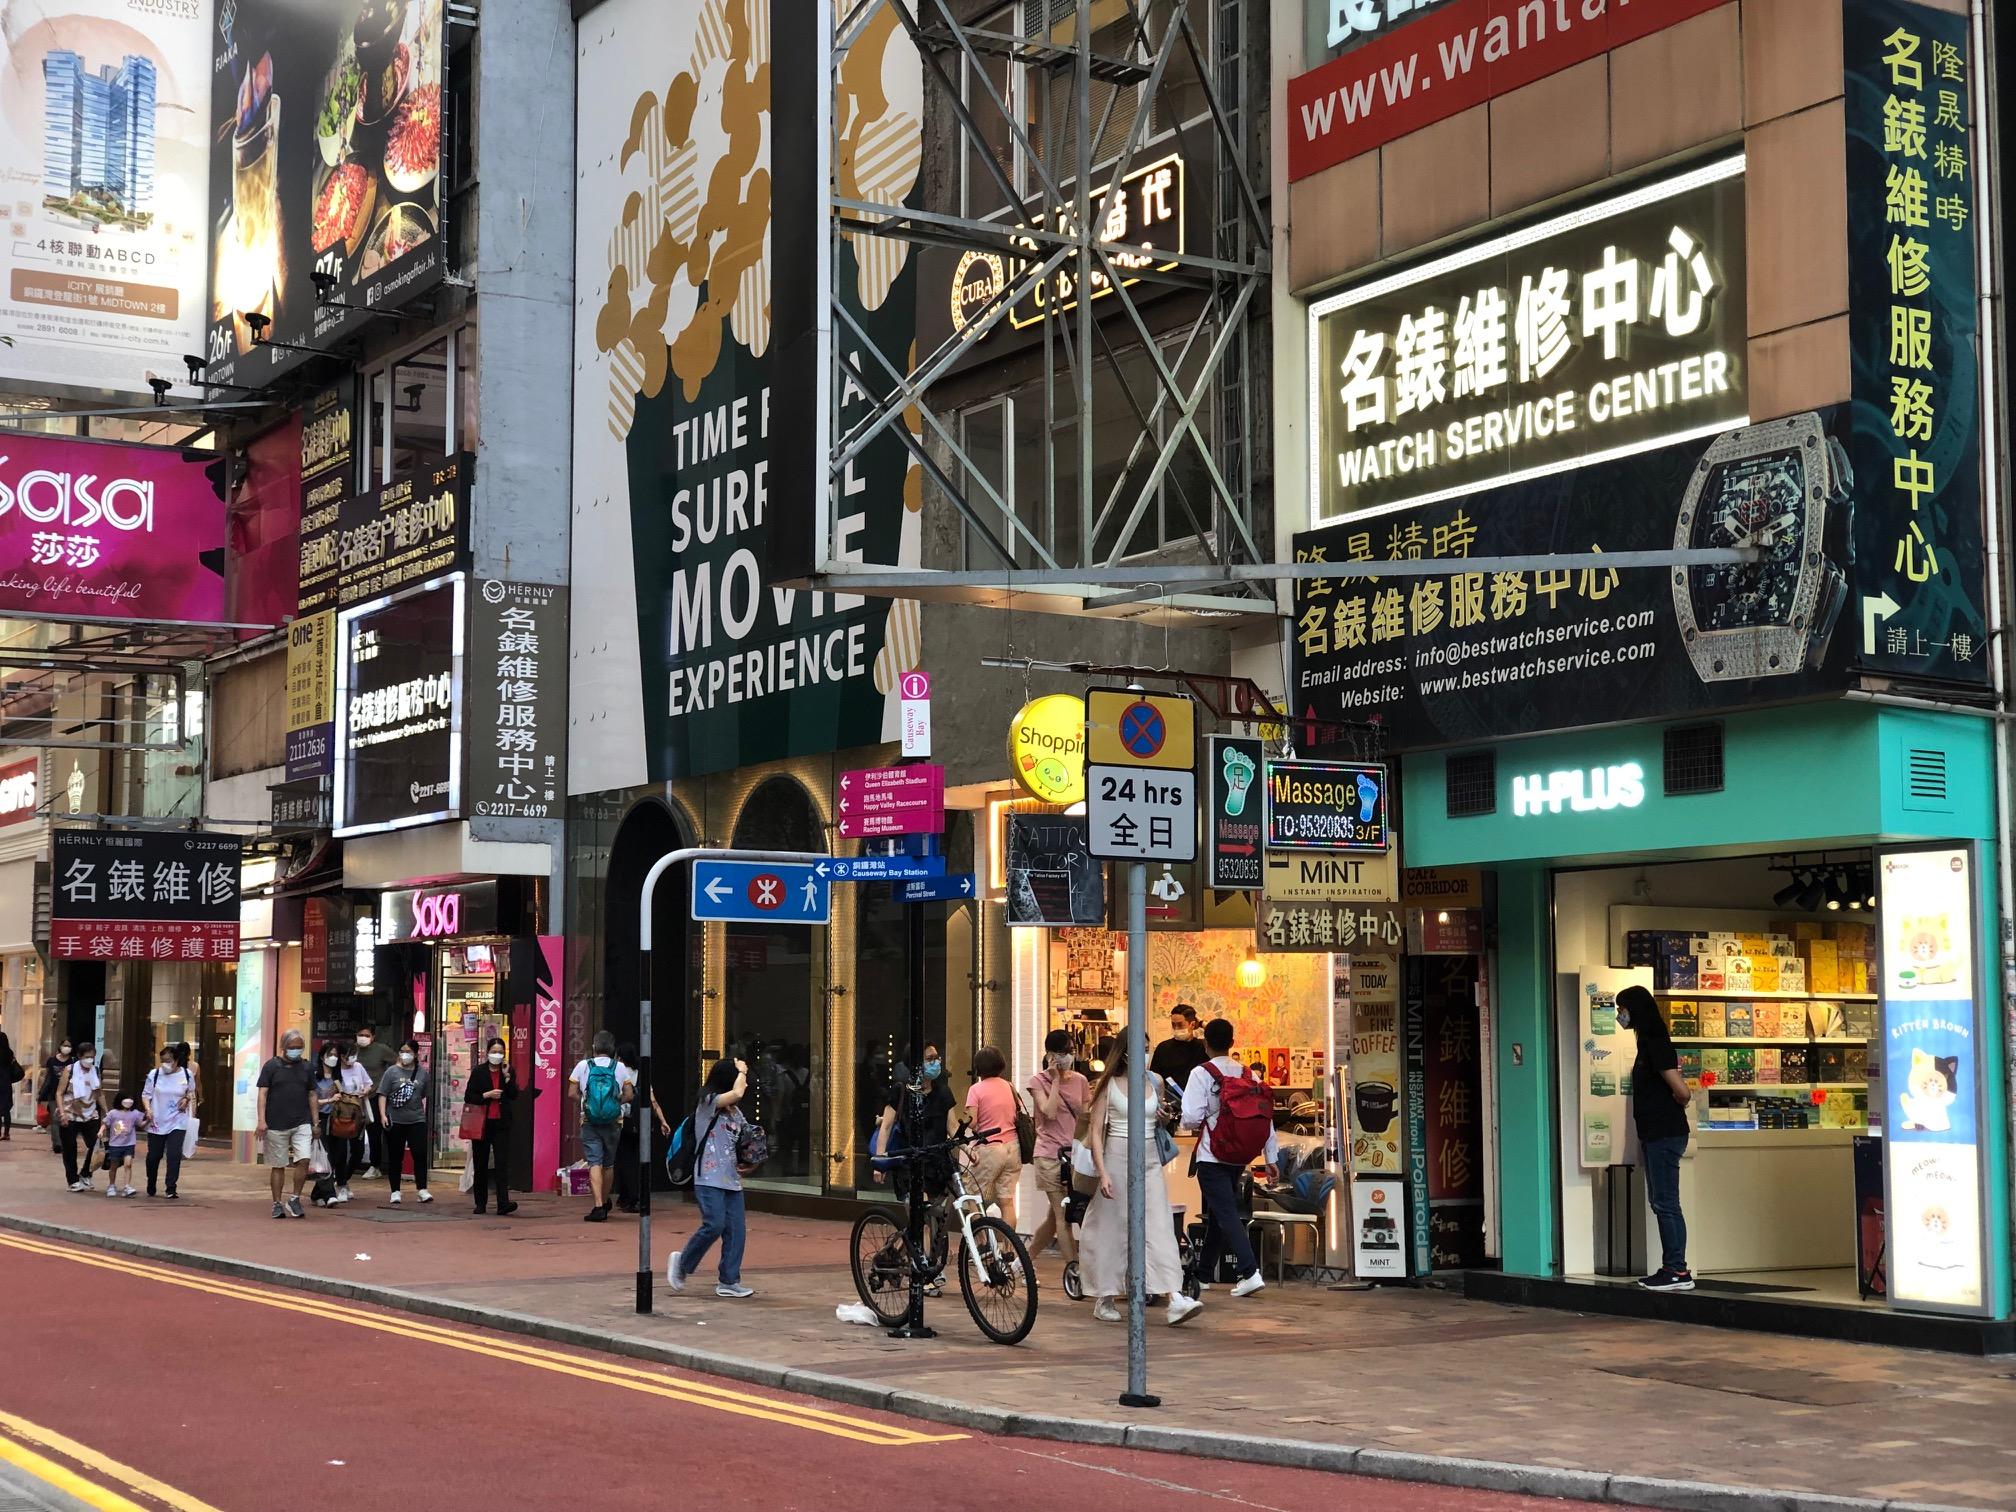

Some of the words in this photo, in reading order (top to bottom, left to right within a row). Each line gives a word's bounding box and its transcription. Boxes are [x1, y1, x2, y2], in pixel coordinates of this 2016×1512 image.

[215, 42, 238, 73] FJAKA
[1932, 39, 1969, 232] 隆晟精時
[960, 277, 992, 306] CUBA
[1882, 27, 1939, 582] 名錶維修服務中心
[1340, 225, 1713, 431] 名錶維修中心
[209, 325, 232, 365] 26/F
[672, 396, 748, 471] TIME
[1338, 429, 1435, 488] WATCH
[1447, 391, 1575, 460] SERVICE
[1588, 350, 1728, 423] CENTER
[31, 531, 100, 569] 莎莎
[0, 574, 41, 598] aking
[44, 575, 72, 599] life
[75, 579, 142, 604] beautiful
[1301, 664, 1341, 688] Email
[1343, 654, 1407, 681] address:
[1415, 608, 1654, 668] info@bestwatchservice.com
[669, 623, 866, 717] EXPERIENCE
[1341, 684, 1405, 709] Website:
[1420, 640, 1655, 698] www.bestwatchservice.com
[495, 607, 539, 800] 名錶維修服務中心
[904, 706, 916, 750] Causeway
[915, 720, 927, 737] Bay
[289, 742, 306, 762] 2111
[307, 737, 326, 757] 2636
[882, 779, 904, 787] Elizabeth
[906, 777, 927, 785] Stadium
[1101, 777, 1136, 802] 24
[1144, 780, 1182, 806] hrs
[1275, 775, 1356, 813] Massage
[490, 803, 548, 817] 2217-6699
[864, 803, 879, 811] Happy
[880, 801, 895, 809] Valley
[896, 799, 927, 807] Racecourse
[58, 834, 102, 847] HÉRNLY
[863, 826, 880, 834] Racing
[881, 824, 903, 832] Museum
[1110, 813, 1172, 849] 全日
[1218, 819, 1259, 844] Massage
[1356, 825, 1381, 840] 3/F
[197, 842, 216, 850] 2217
[218, 843, 238, 851] 6699
[61, 858, 236, 905] 名錶維修
[1218, 858, 1259, 880] 95320835
[1407, 878, 1468, 896] CORRIDOR
[1267, 907, 1402, 946] 名錶維修中心
[58, 936, 235, 958] 手袋維修護理
[1360, 975, 1388, 989] TODAY
[1356, 1004, 1362, 1016] A
[1364, 1004, 1389, 1016] DAMN
[1370, 1019, 1394, 1032] FINE
[1353, 1034, 1397, 1055] COFFEE
[1439, 957, 1472, 1190] 名錶維修
[1409, 1071, 1418, 1146] INSPIRATION
[1415, 1071, 1424, 1120] INSTANT
[1412, 1154, 1429, 1247] Polaroid
